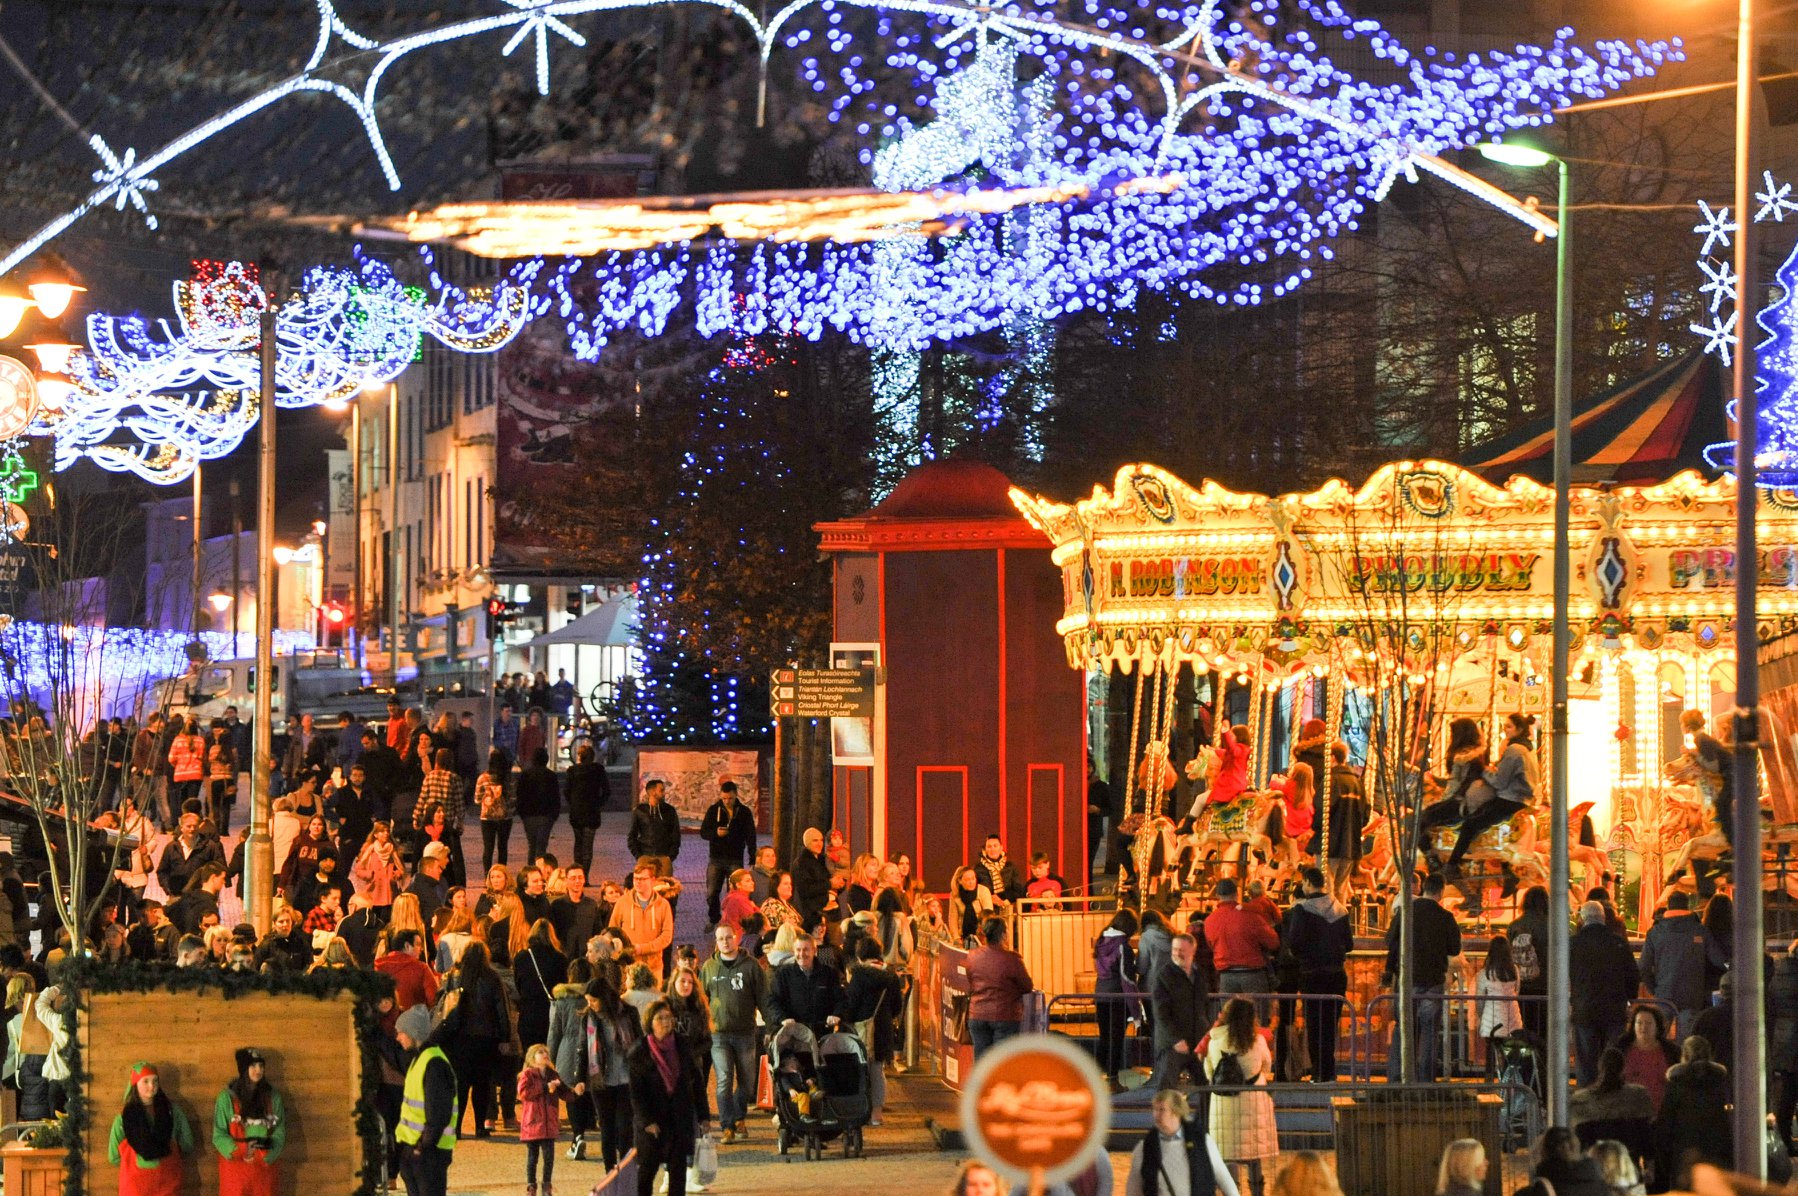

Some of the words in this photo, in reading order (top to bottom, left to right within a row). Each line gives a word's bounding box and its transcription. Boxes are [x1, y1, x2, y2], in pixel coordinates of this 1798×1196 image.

[1129, 557, 1260, 597] ROBINSON
[1347, 553, 1540, 592] PROUDLY
[798, 693, 817, 701] Viking
[818, 693, 843, 701] Triangle
[829, 709, 850, 717] Crystal
